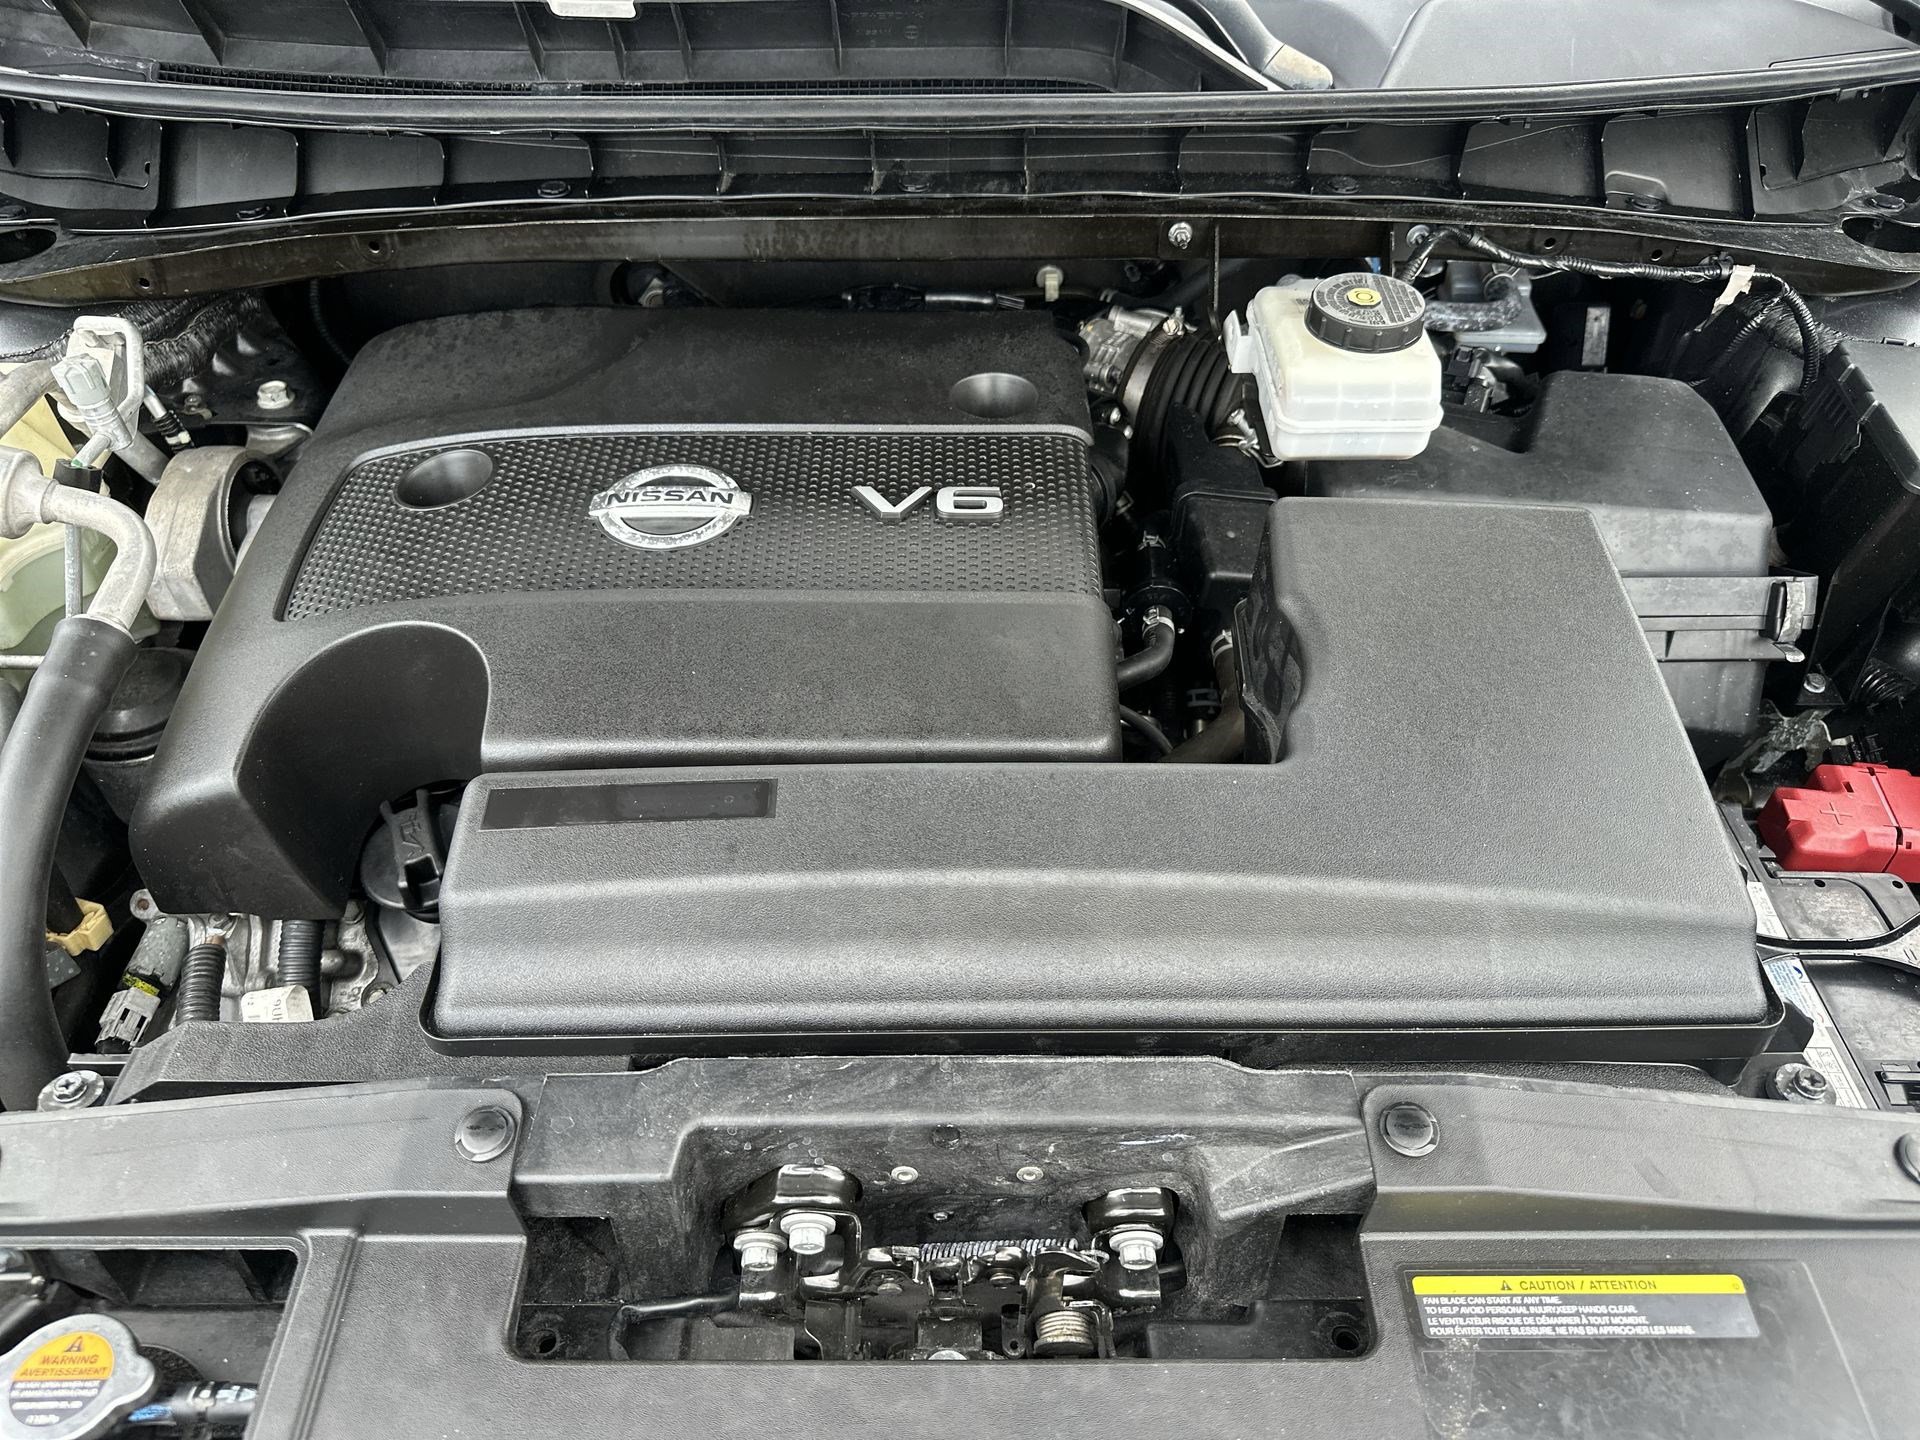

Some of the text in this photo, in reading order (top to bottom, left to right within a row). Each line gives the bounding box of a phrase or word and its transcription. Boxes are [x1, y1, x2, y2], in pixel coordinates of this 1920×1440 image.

[606, 489, 735, 506] NISSAN
[851, 485, 1005, 520] V6
[1519, 1280, 1576, 1291] CAUTION
[1589, 1280, 1658, 1290] ATTENTION
[1423, 1296, 1439, 1305] FAN
[1440, 1296, 1467, 1305] BLADE
[1468, 1296, 1486, 1305] CAN
[1486, 1296, 1511, 1305] START
[1513, 1296, 1522, 1304] AT
[1523, 1296, 1540, 1304] ANY
[1425, 1306, 1437, 1314] TO
[1438, 1306, 1459, 1314] HELP
[1460, 1306, 1485, 1314] AVOID
[1486, 1306, 1529, 1314] PERSONAL
[1579, 1305, 1607, 1314] HANDS
[1427, 1317, 1439, 1325] LE
[1492, 1317, 1522, 1325] RISQUE
[1523, 1317, 1535, 1325] DE
[1589, 1316, 1610, 1324] TOUT
[1430, 1327, 1454, 1335] POUR
[1483, 1327, 1509, 1335] TOUTE
[1556, 1327, 1568, 1335] NE
[1568, 1326, 1585, 1335] PAS
[1586, 1326, 1598, 1334] EN
[1599, 1326, 1650, 1334] APPROCHER
[1650, 1326, 1666, 1334] LES
[41, 1354, 99, 1365] WARNING
[20, 1366, 108, 1377] AVERTISSEMENT
